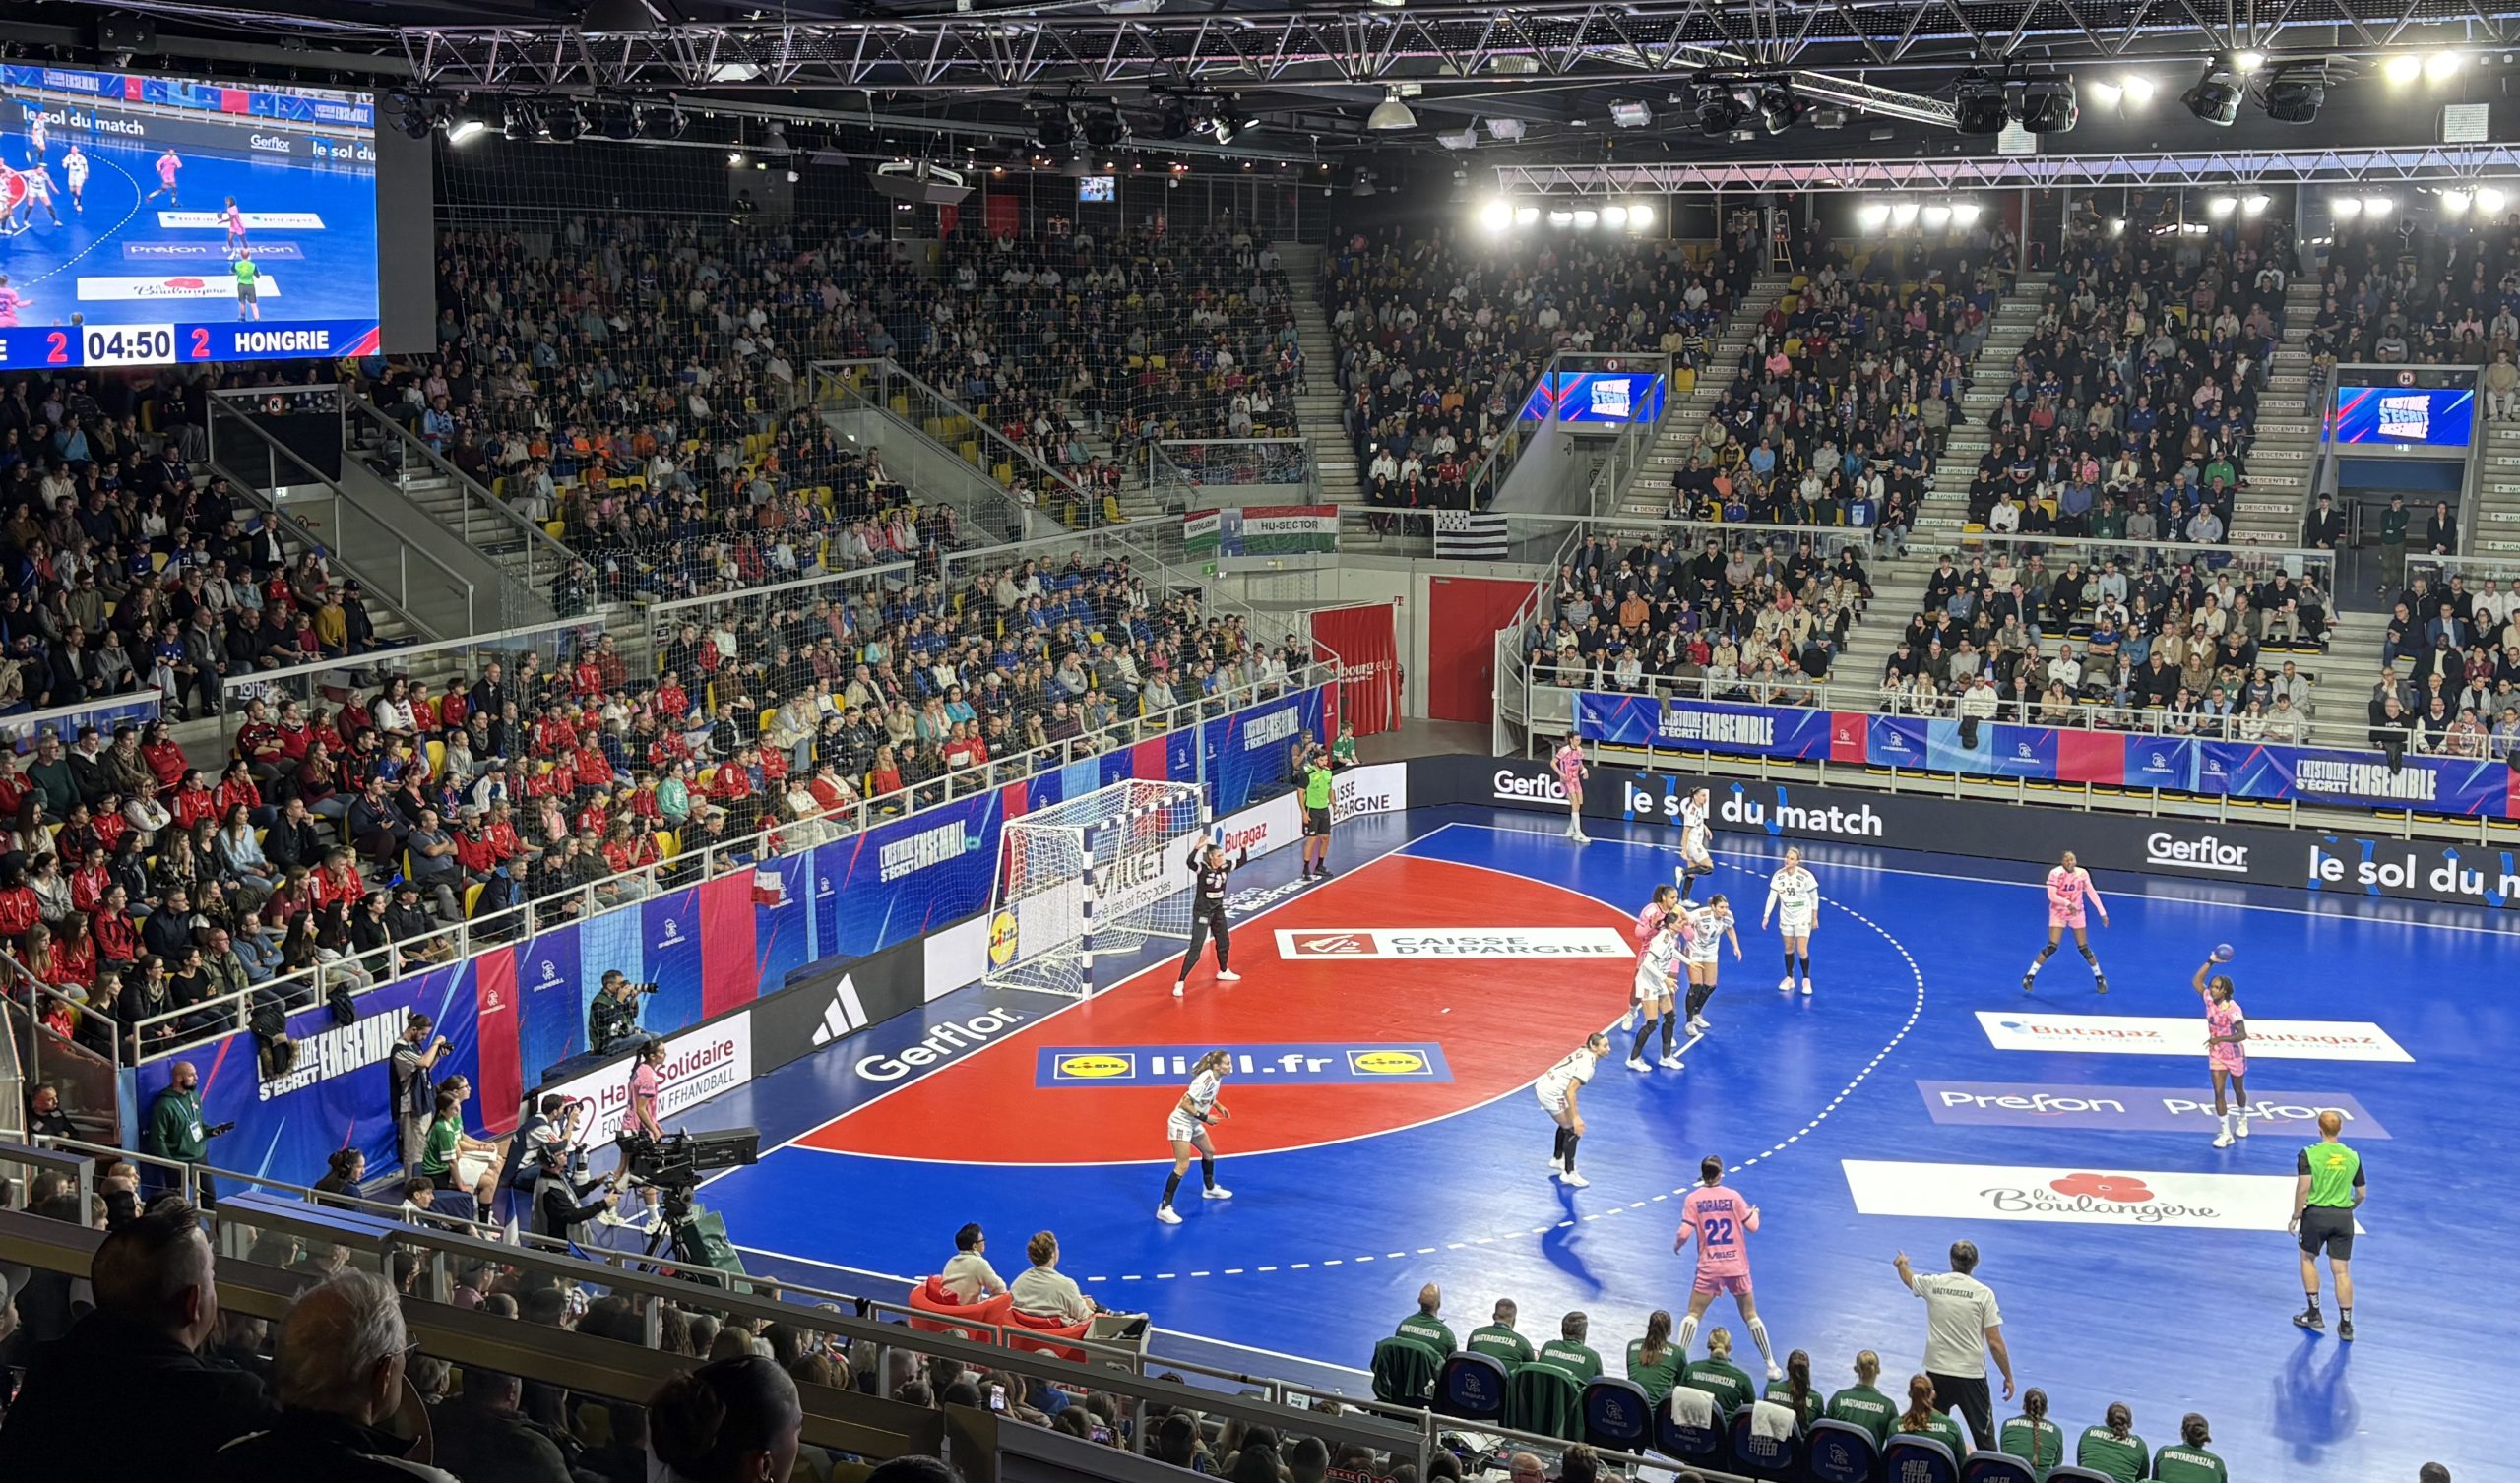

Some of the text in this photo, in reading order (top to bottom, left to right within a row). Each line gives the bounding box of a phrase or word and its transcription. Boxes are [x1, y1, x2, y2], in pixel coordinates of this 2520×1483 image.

[23, 105, 37, 120] le
[70, 112, 91, 128] du
[95, 118, 144, 136] match
[251, 134, 290, 151] Gerflor
[313, 141, 326, 155] le
[331, 145, 352, 158] sol
[46, 329, 330, 363] 2 04:50 2 HONGRIE
[1261, 520, 1319, 530] HU-SECTOR
[1701, 712, 1774, 745] ENSEMBLE
[1493, 770, 1567, 799] Gerflo
[2296, 759, 2349, 781] L'HISTOIRE
[2349, 764, 2437, 801] ENSEMBLE
[1624, 781, 1882, 837] le sol du match
[914, 819, 966, 871] ENSEMBLE
[1224, 822, 1268, 853] Butagaz
[2147, 832, 2248, 868] Gerflor
[2310, 845, 2344, 882] le
[2357, 853, 2415, 889] sol
[2429, 858, 2484, 896] du
[1391, 936, 1527, 946] CAISSE
[1396, 944, 1616, 955] D'EPARGNE
[855, 1006, 1022, 1081] Gerflor
[2032, 1024, 2376, 1045] Butagaz Butagaz
[601, 1039, 734, 1110] Ha Solidaire
[1152, 1053, 1333, 1075] lil.fr
[668, 1067, 735, 1109] FFHANDBALL
[1980, 1188, 2221, 1223] Boulangère
[2033, 1188, 2061, 1202] la
[1704, 1217, 1734, 1246] 22
[1901, 1459, 1929, 1474] #BLEU
